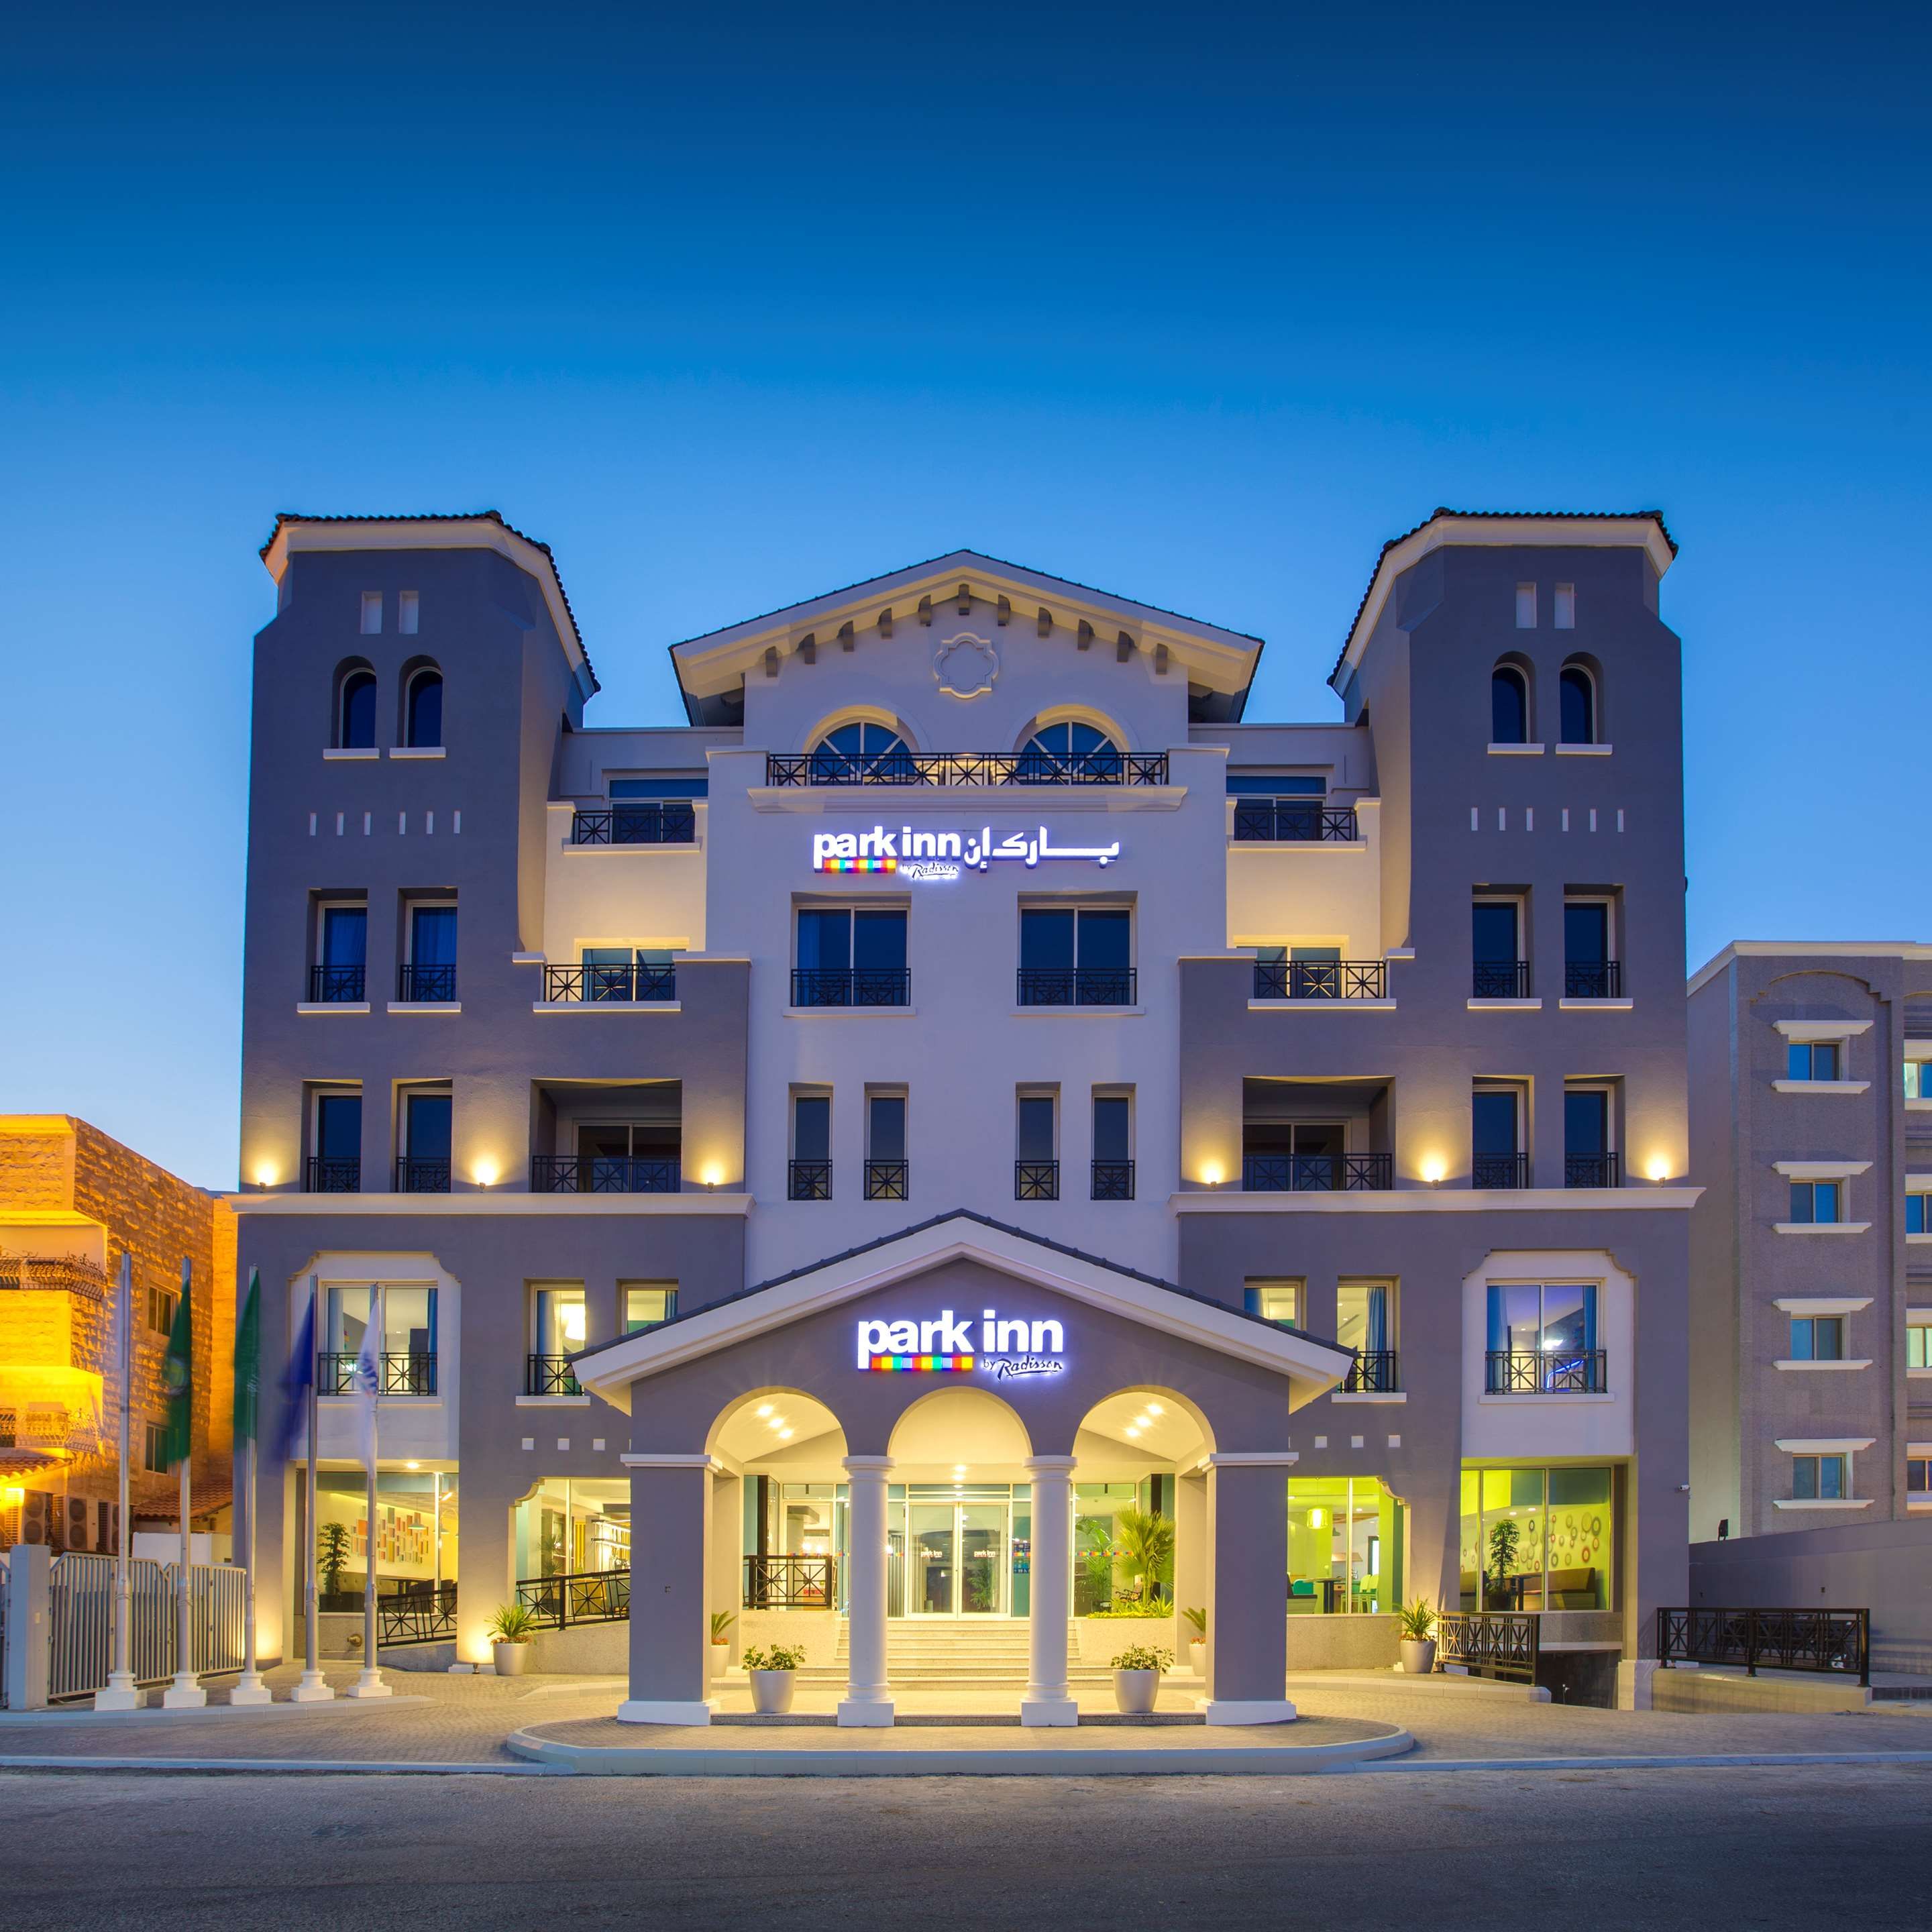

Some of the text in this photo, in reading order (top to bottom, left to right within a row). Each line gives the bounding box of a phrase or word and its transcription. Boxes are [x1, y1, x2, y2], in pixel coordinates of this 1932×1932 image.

[814, 826, 961, 870] park inn
[857, 1309, 1063, 1369] park inn
[983, 1355, 1063, 1381] by Radisson
